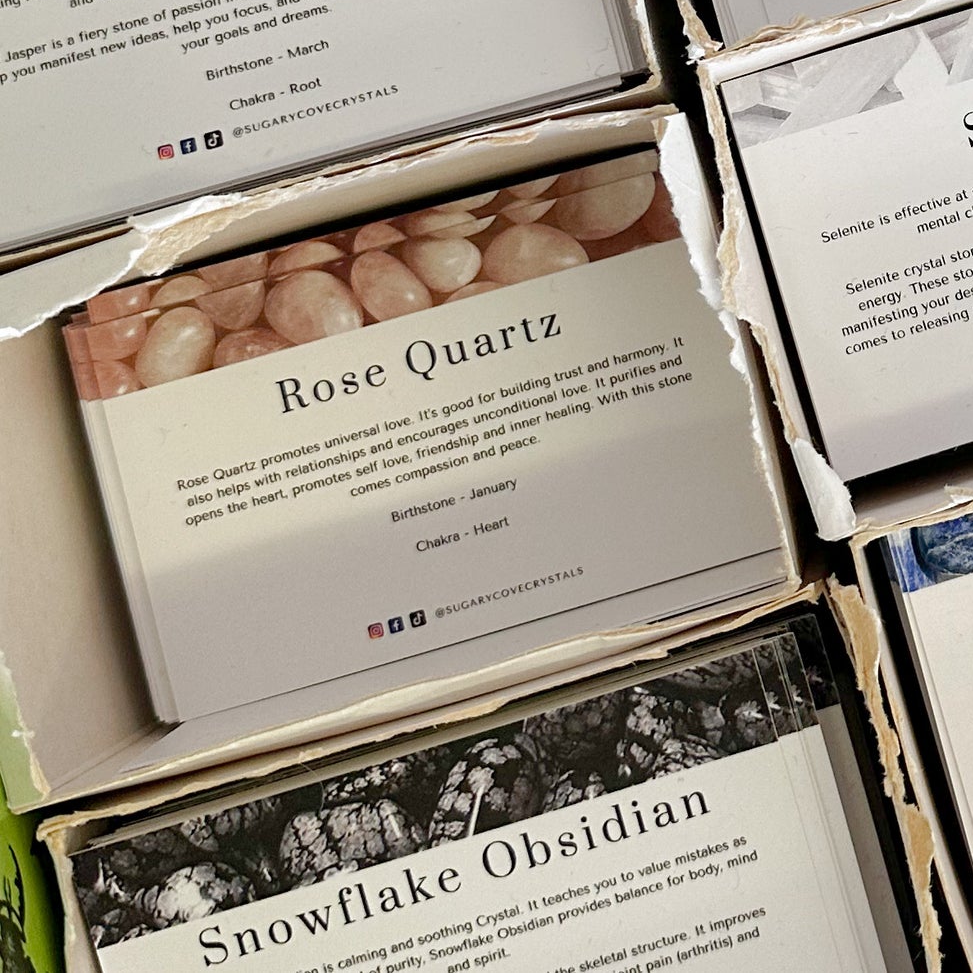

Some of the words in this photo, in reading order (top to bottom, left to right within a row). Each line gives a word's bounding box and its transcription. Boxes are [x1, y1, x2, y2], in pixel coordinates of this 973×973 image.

[180, 36, 210, 54] your
[214, 25, 250, 45] goals
[253, 16, 277, 32] and
[281, 4, 332, 24] dreams.
[205, 56, 273, 81] Birthstone
[286, 39, 329, 58] March
[232, 84, 398, 138] @SUGARYCOVECRYSTALS
[916, 210, 960, 233] mental
[275, 364, 386, 413] Rose
[405, 313, 561, 381] Quartz
[349, 478, 391, 497] comes
[394, 455, 469, 484] compassion
[472, 444, 496, 461] and
[499, 435, 540, 457] peace.
[390, 496, 456, 522] Birthstone
[469, 478, 517, 500] January
[434, 566, 583, 618] @SUGARYCOVECRYSTALS
[198, 868, 461, 967] Snowflake
[481, 791, 710, 878] Obsidian
[385, 956, 426, 973] purity,
[428, 934, 494, 960] Snowflake
[496, 915, 554, 939] Obsidian
[557, 898, 612, 924] provides
[614, 881, 663, 903] balance
[666, 874, 685, 887] for
[688, 863, 723, 880] body,
[726, 849, 758, 868] mind
[447, 958, 470, 973] and
[473, 947, 513, 967] spirit.
[578, 947, 627, 972] skeletal
[630, 932, 694, 956] structure.
[694, 923, 706, 937] It
[708, 907, 766, 932] improves
